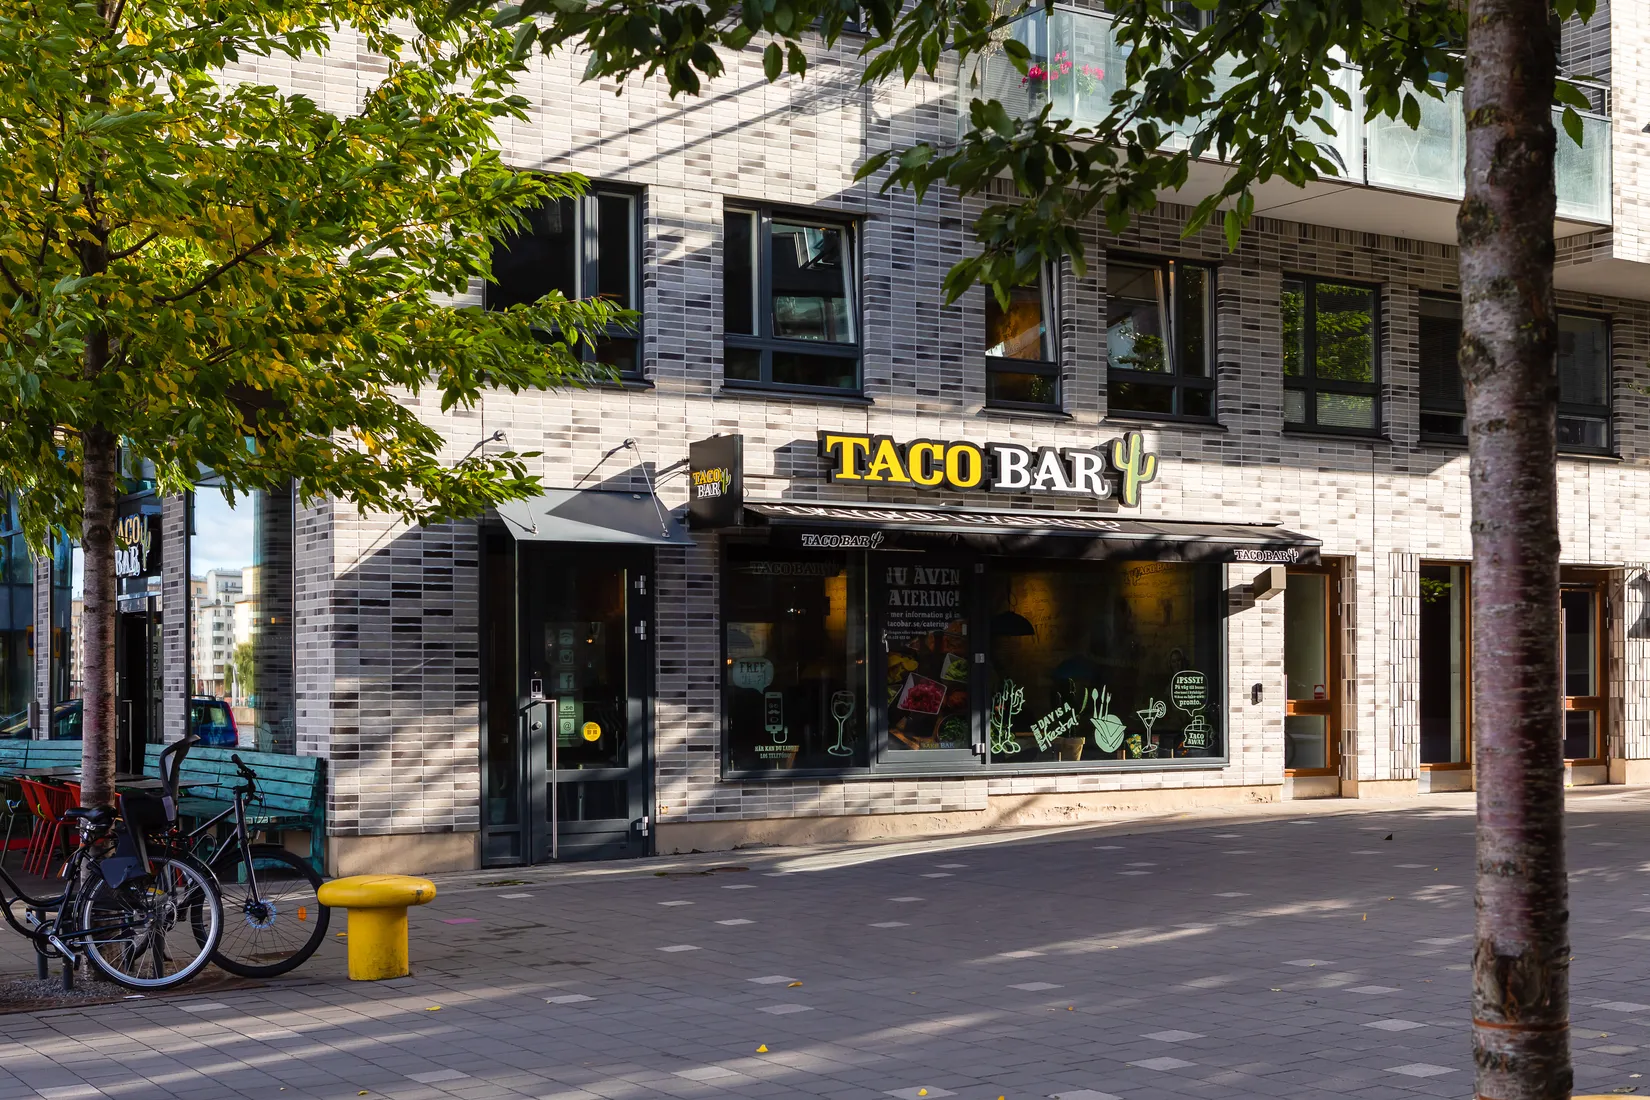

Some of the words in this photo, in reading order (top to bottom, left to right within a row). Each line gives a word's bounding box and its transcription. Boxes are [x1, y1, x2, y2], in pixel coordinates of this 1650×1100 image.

[825, 435, 983, 488] TACO
[993, 446, 1109, 496] BAR
[692, 468, 721, 485] TACO
[697, 481, 721, 499] BAR
[116, 514, 141, 546] ACO
[802, 534, 840, 547] TACO
[839, 535, 870, 548] BAR
[1234, 549, 1264, 561] TACO
[1264, 550, 1290, 562] BAR
[913, 565, 961, 586] ÄVEN
[888, 589, 960, 607] ATERING!
[905, 610, 944, 618] information
[887, 620, 949, 630] tacobar.se/catering
[1037, 711, 1055, 730] DAY
[1055, 707, 1064, 718] IS
[1063, 702, 1072, 713] A
